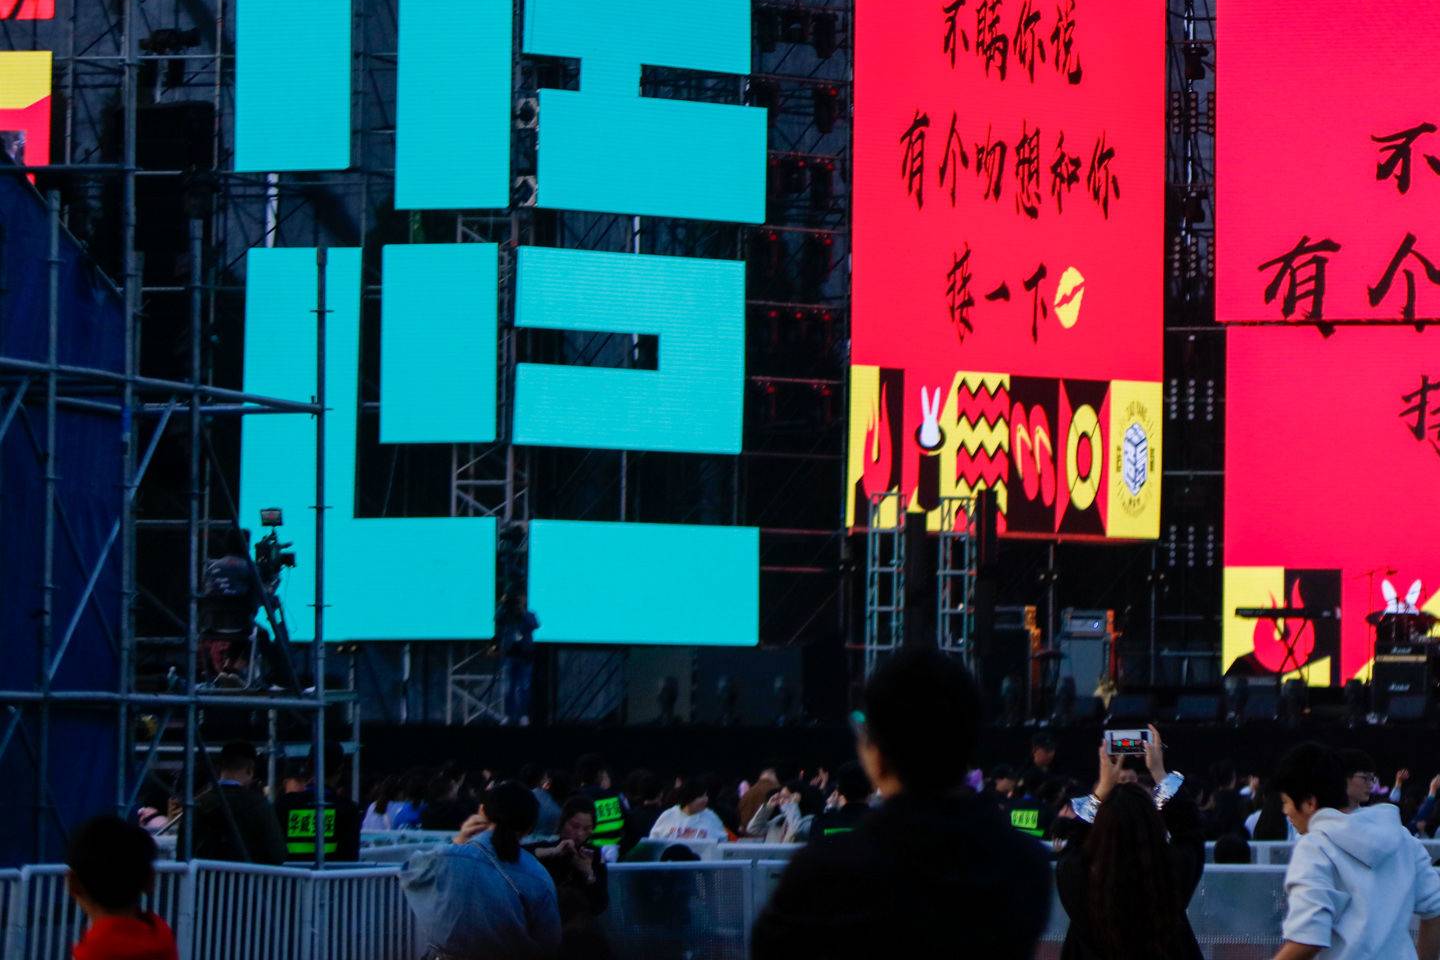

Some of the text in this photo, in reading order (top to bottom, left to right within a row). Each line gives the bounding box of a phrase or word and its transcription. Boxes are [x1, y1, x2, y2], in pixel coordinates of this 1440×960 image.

[899, 108, 1121, 221] 有个吻想和你
[947, 241, 1048, 343] 接一下
